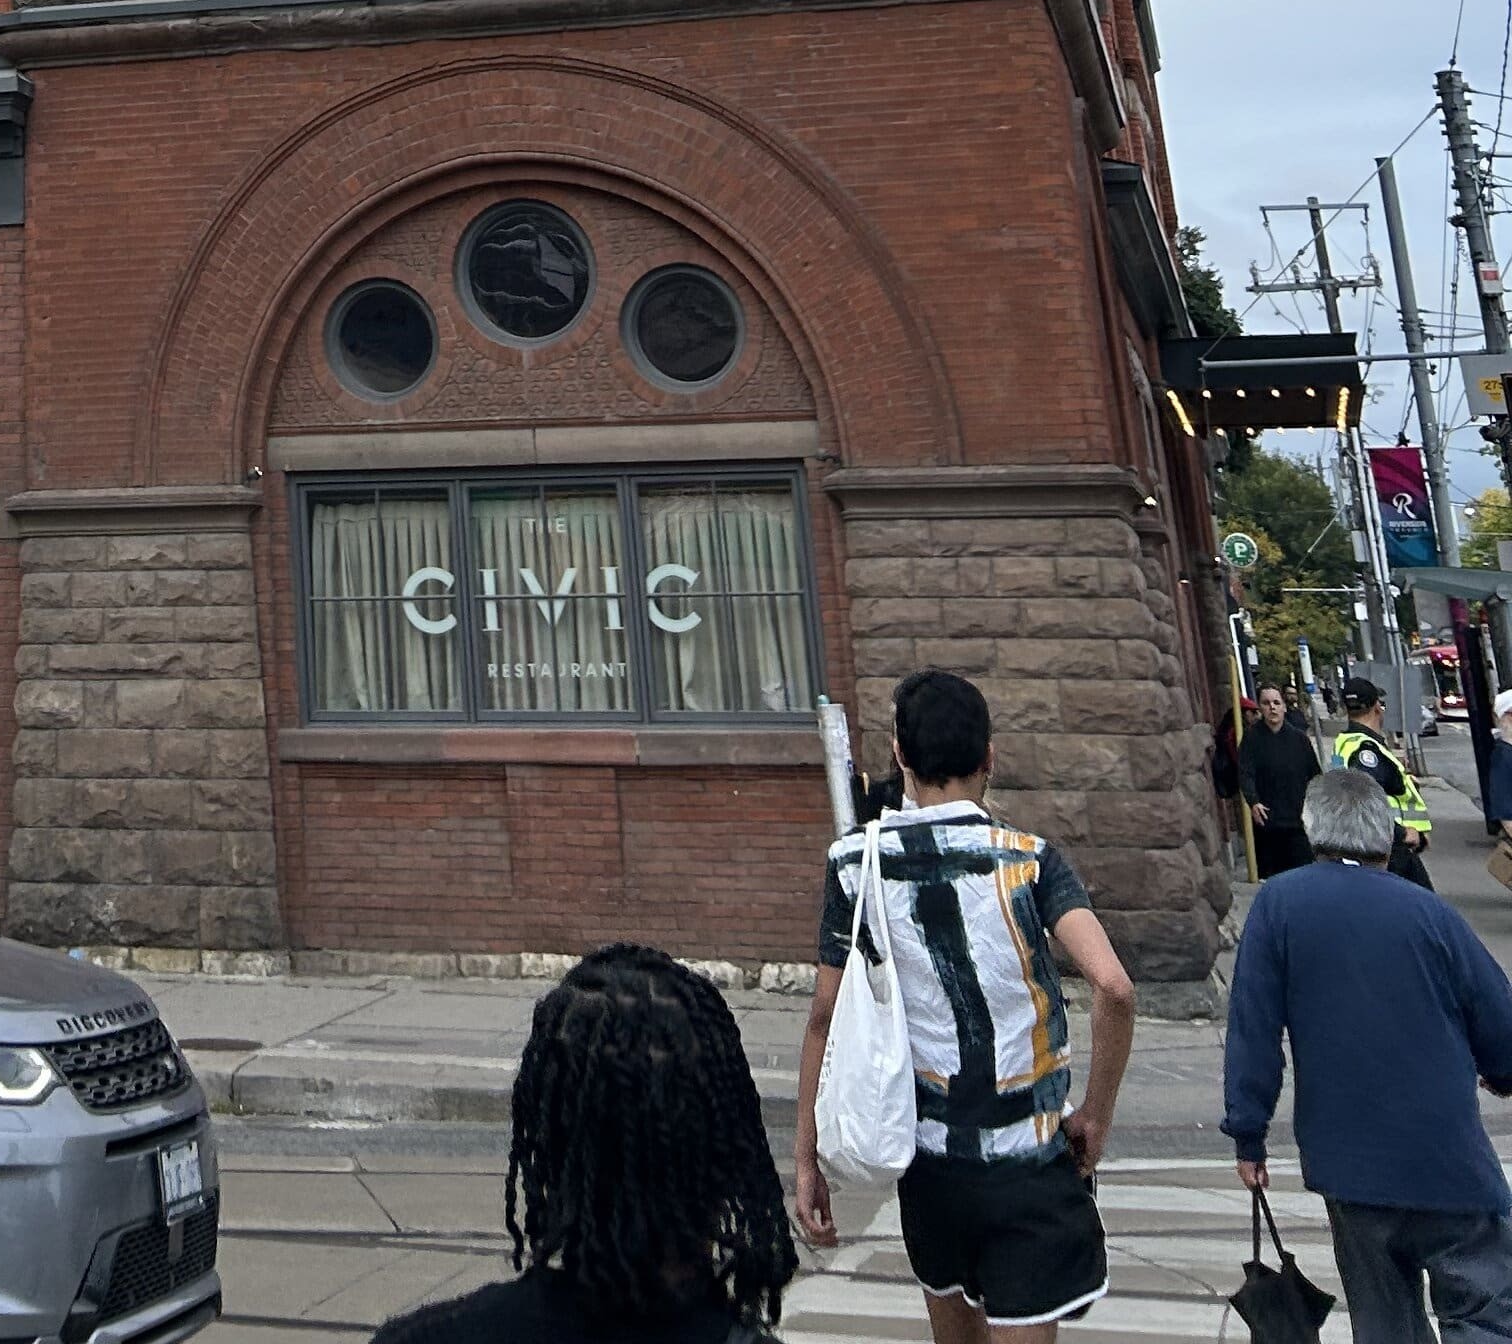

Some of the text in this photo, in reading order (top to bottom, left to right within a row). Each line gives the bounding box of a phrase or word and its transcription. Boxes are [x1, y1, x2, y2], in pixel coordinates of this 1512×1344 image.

[402, 563, 702, 634] CIVIC
[487, 662, 626, 678] RESTAURANT
[56, 1000, 150, 1035] DISCOVERY
